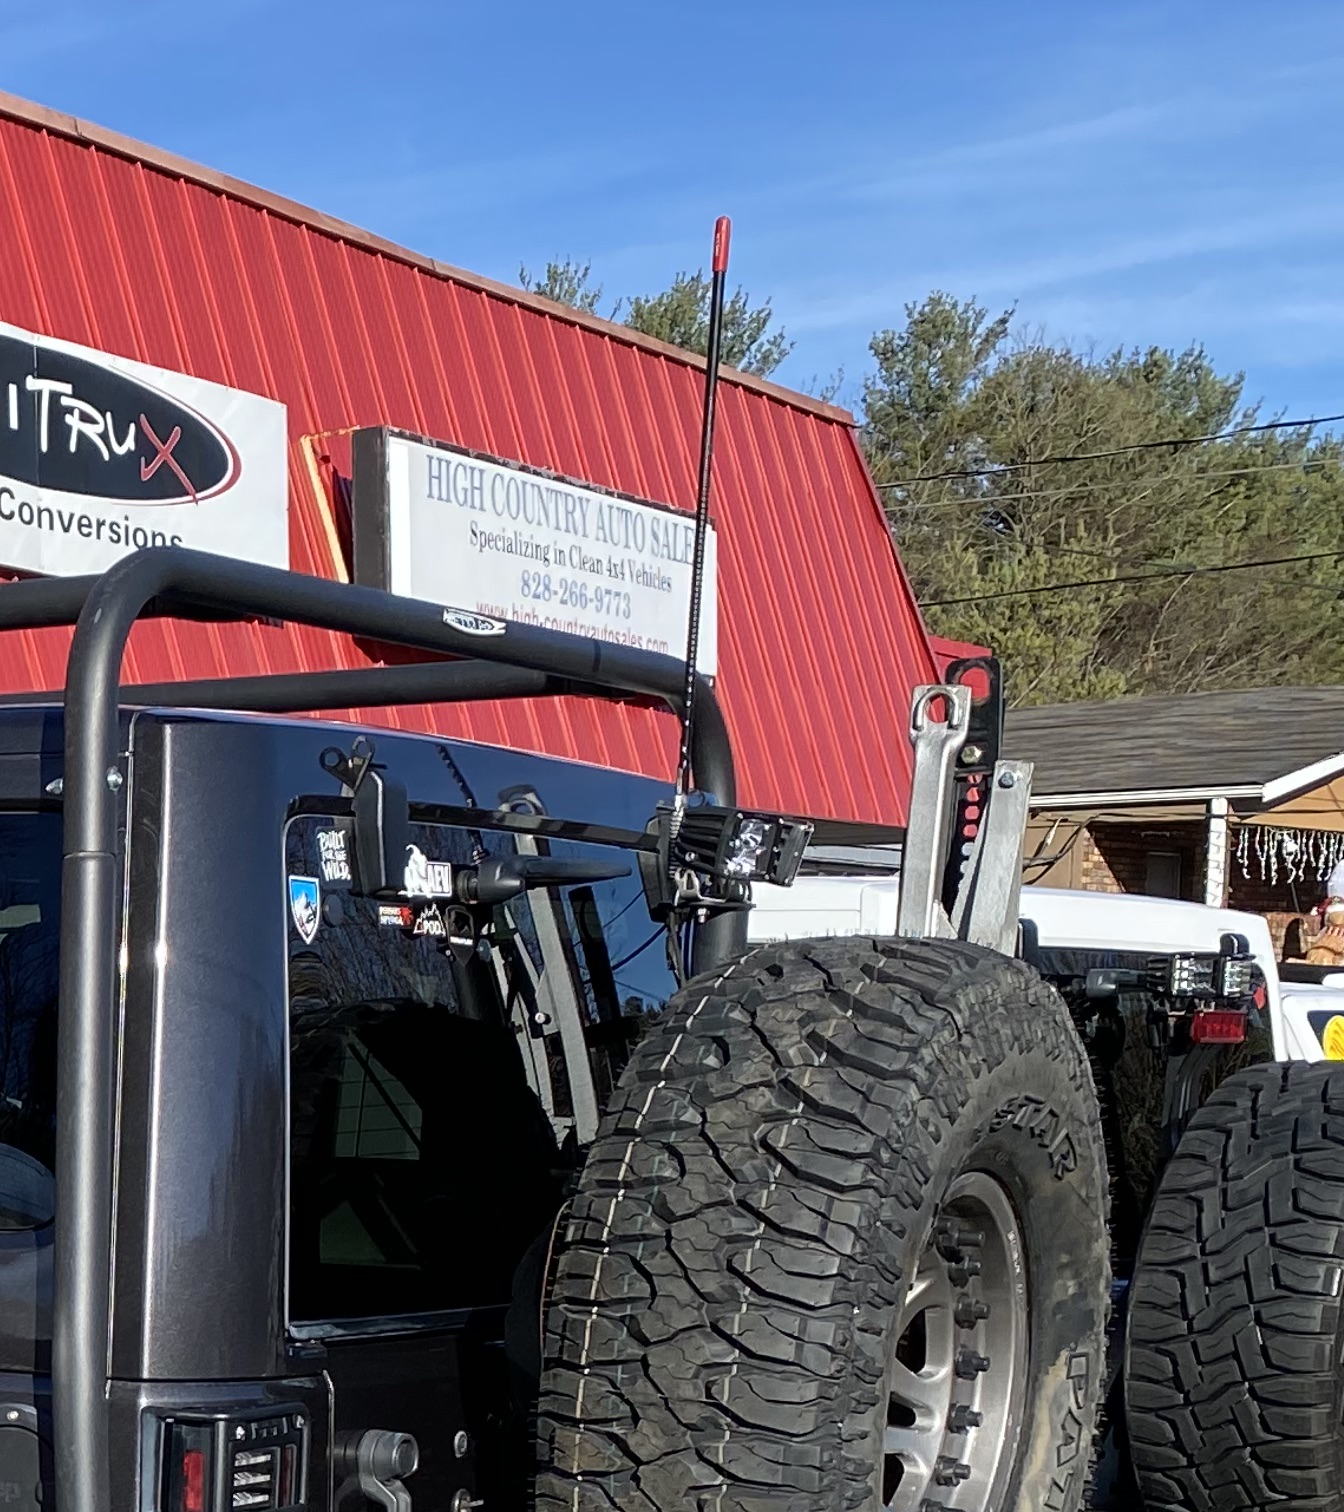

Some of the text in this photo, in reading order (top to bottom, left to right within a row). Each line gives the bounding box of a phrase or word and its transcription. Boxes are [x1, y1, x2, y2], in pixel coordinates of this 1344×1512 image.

[426, 455, 695, 566] HIGH COUNTRY AUTO SALE
[468, 520, 673, 594] Specializing in Clean 4x4 Vehicles
[519, 569, 632, 620] 828-266-9773
